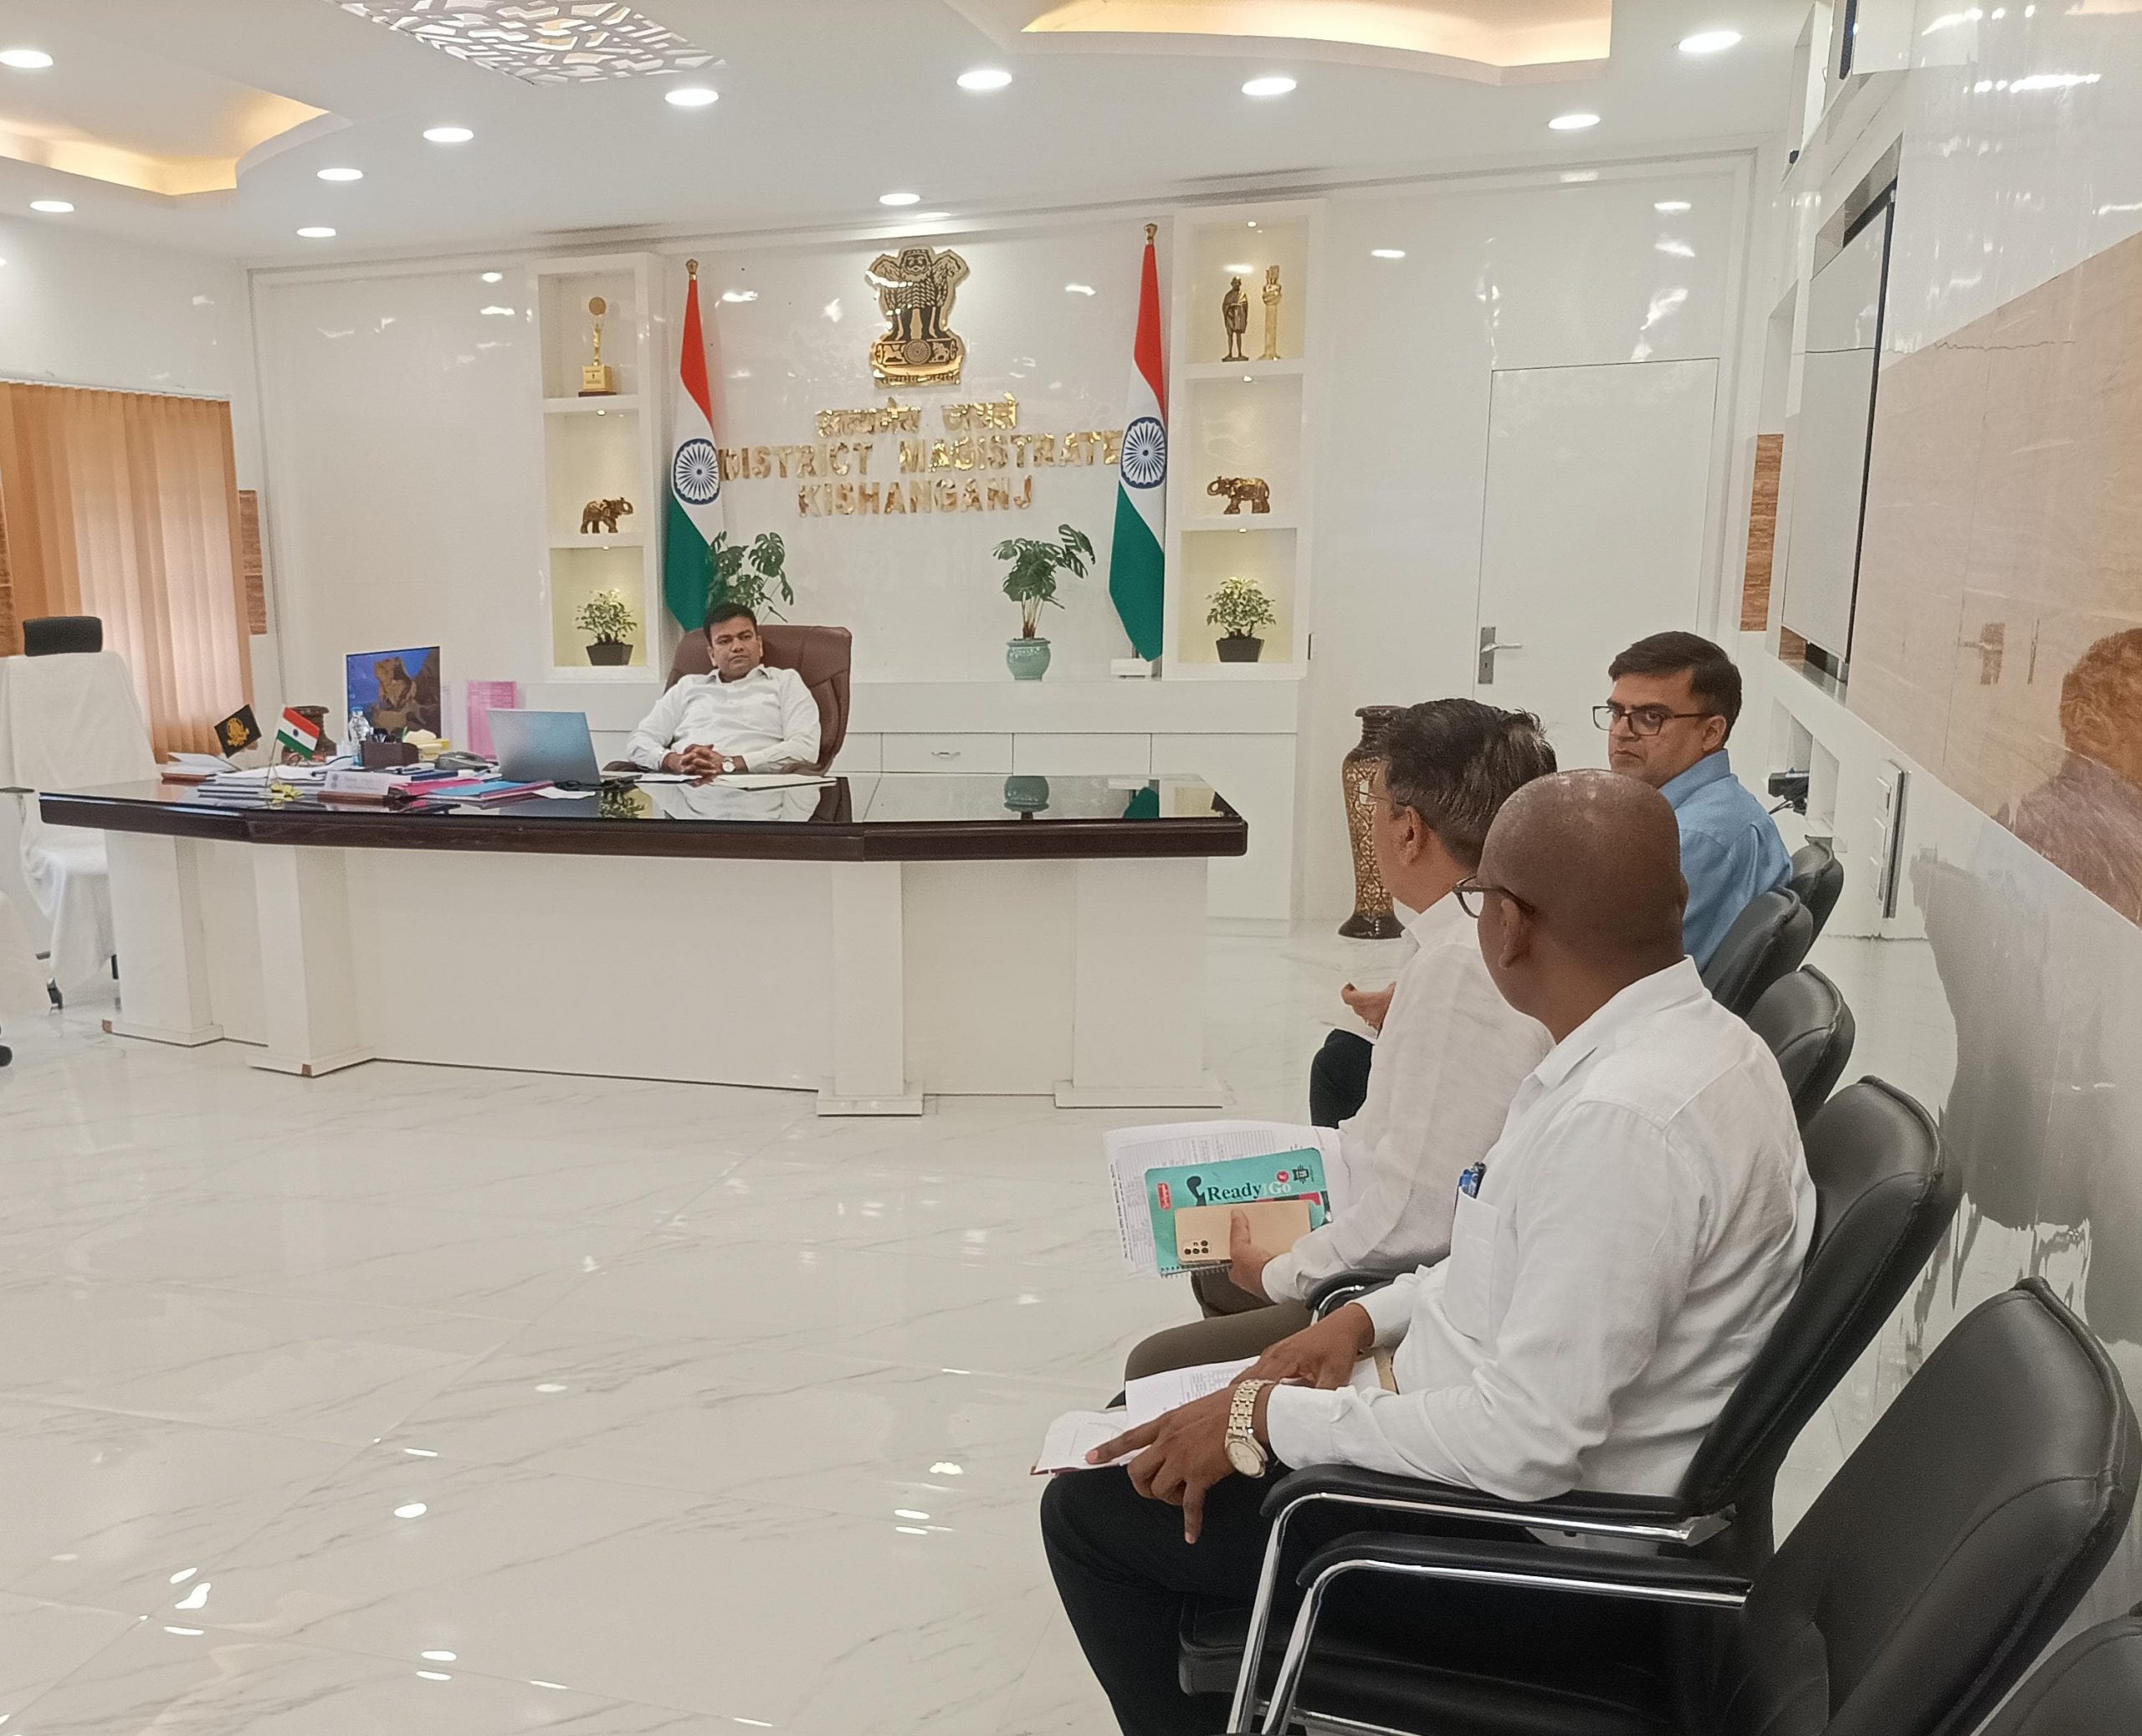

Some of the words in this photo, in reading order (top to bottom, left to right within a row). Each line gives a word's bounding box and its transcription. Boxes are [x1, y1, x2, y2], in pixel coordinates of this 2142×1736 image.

[718, 442, 873, 481] DISTRICT
[899, 430, 1123, 474] MAGISTRATE
[798, 474, 1032, 517] KISHANGANJ
[1207, 1182, 1262, 1201] Ready
[1268, 1182, 1291, 1195] Go
